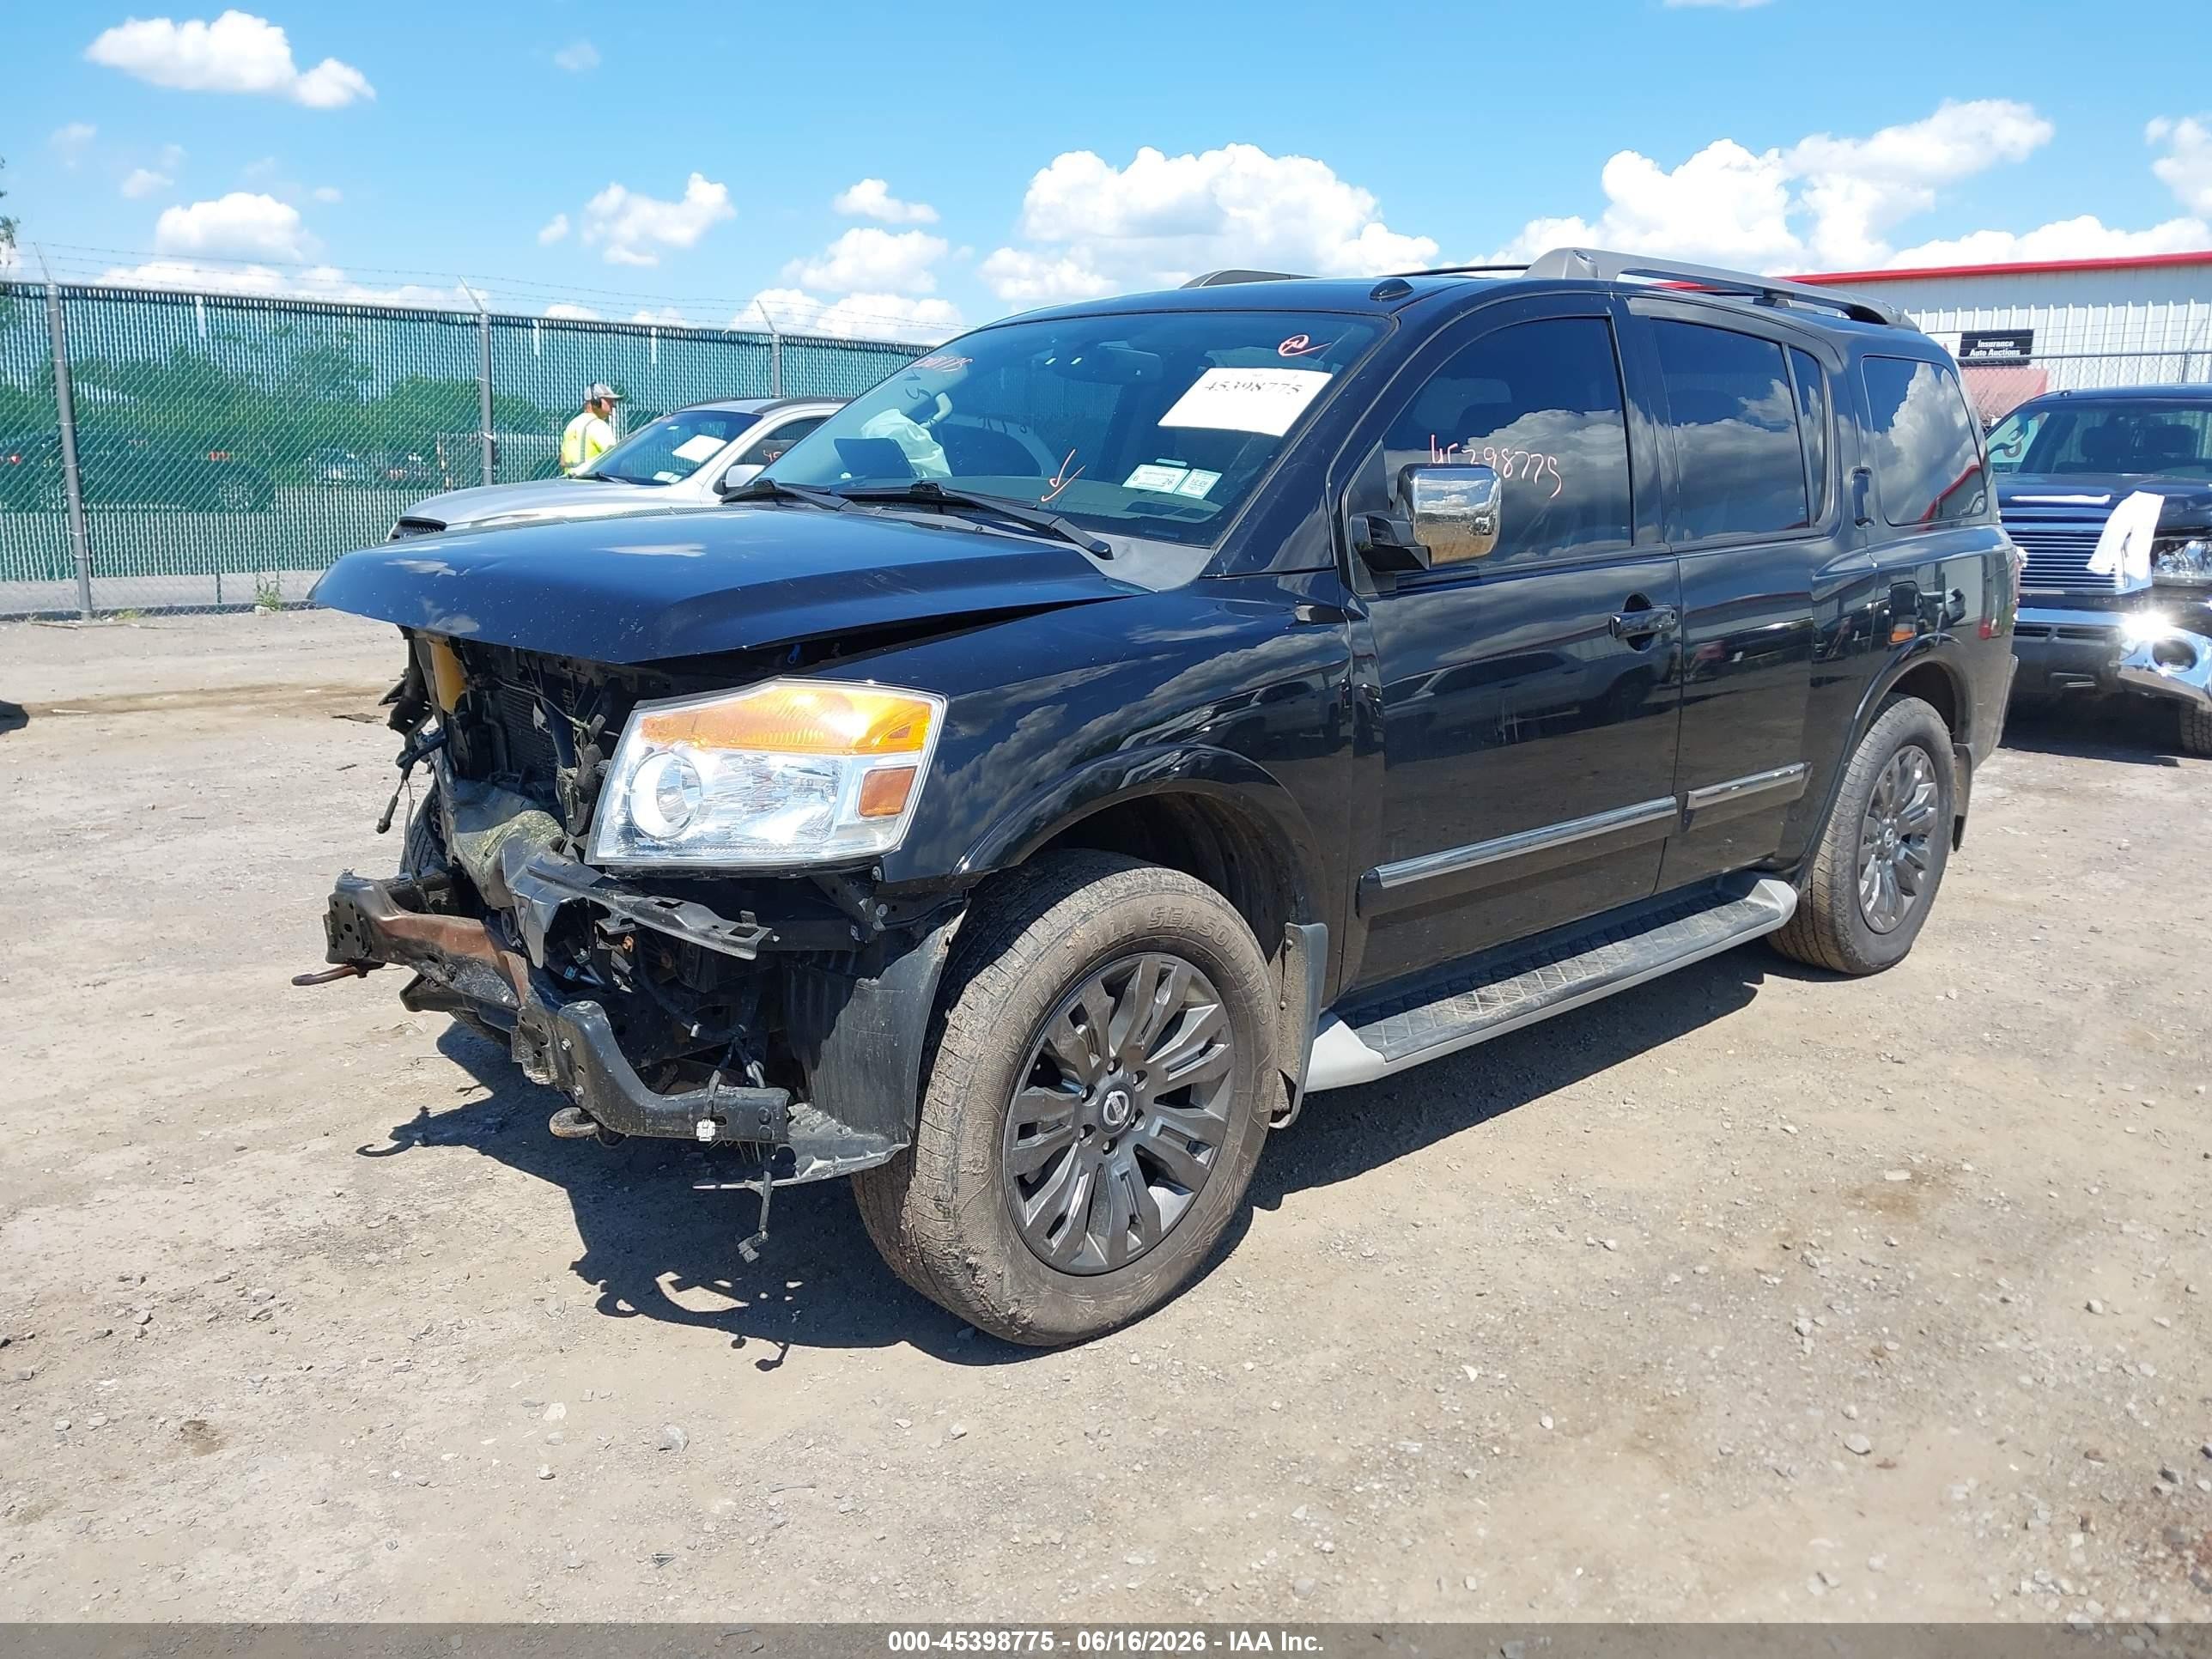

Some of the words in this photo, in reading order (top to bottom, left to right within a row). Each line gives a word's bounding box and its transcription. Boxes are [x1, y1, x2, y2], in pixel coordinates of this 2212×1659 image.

[1988, 348, 2021, 356] Auctions
[1204, 381, 1303, 395] 45398775
[1146, 905, 1244, 960] SEASON
